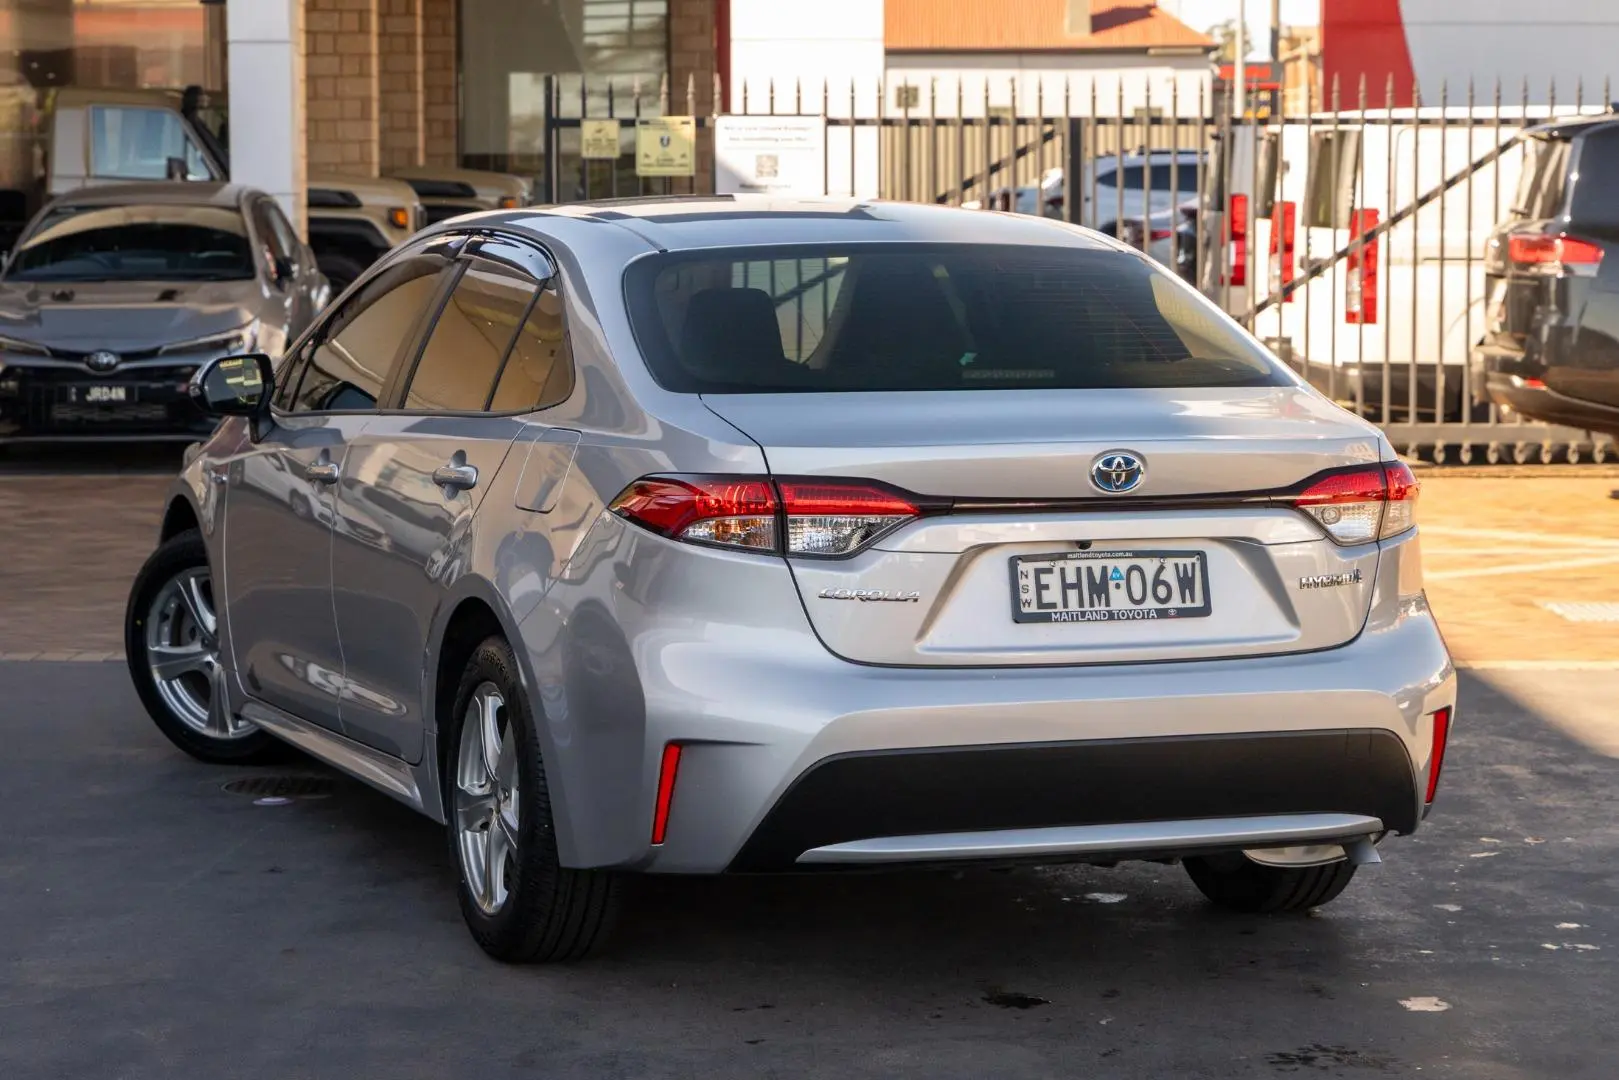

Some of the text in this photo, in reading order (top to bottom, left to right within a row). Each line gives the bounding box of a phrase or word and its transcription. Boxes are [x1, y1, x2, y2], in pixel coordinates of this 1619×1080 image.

[1067, 551, 1133, 559] maitlandtoyota.com.au
[818, 588, 920, 602] COROLLA
[1051, 609, 1158, 622] MAITLAND TOYOTA
